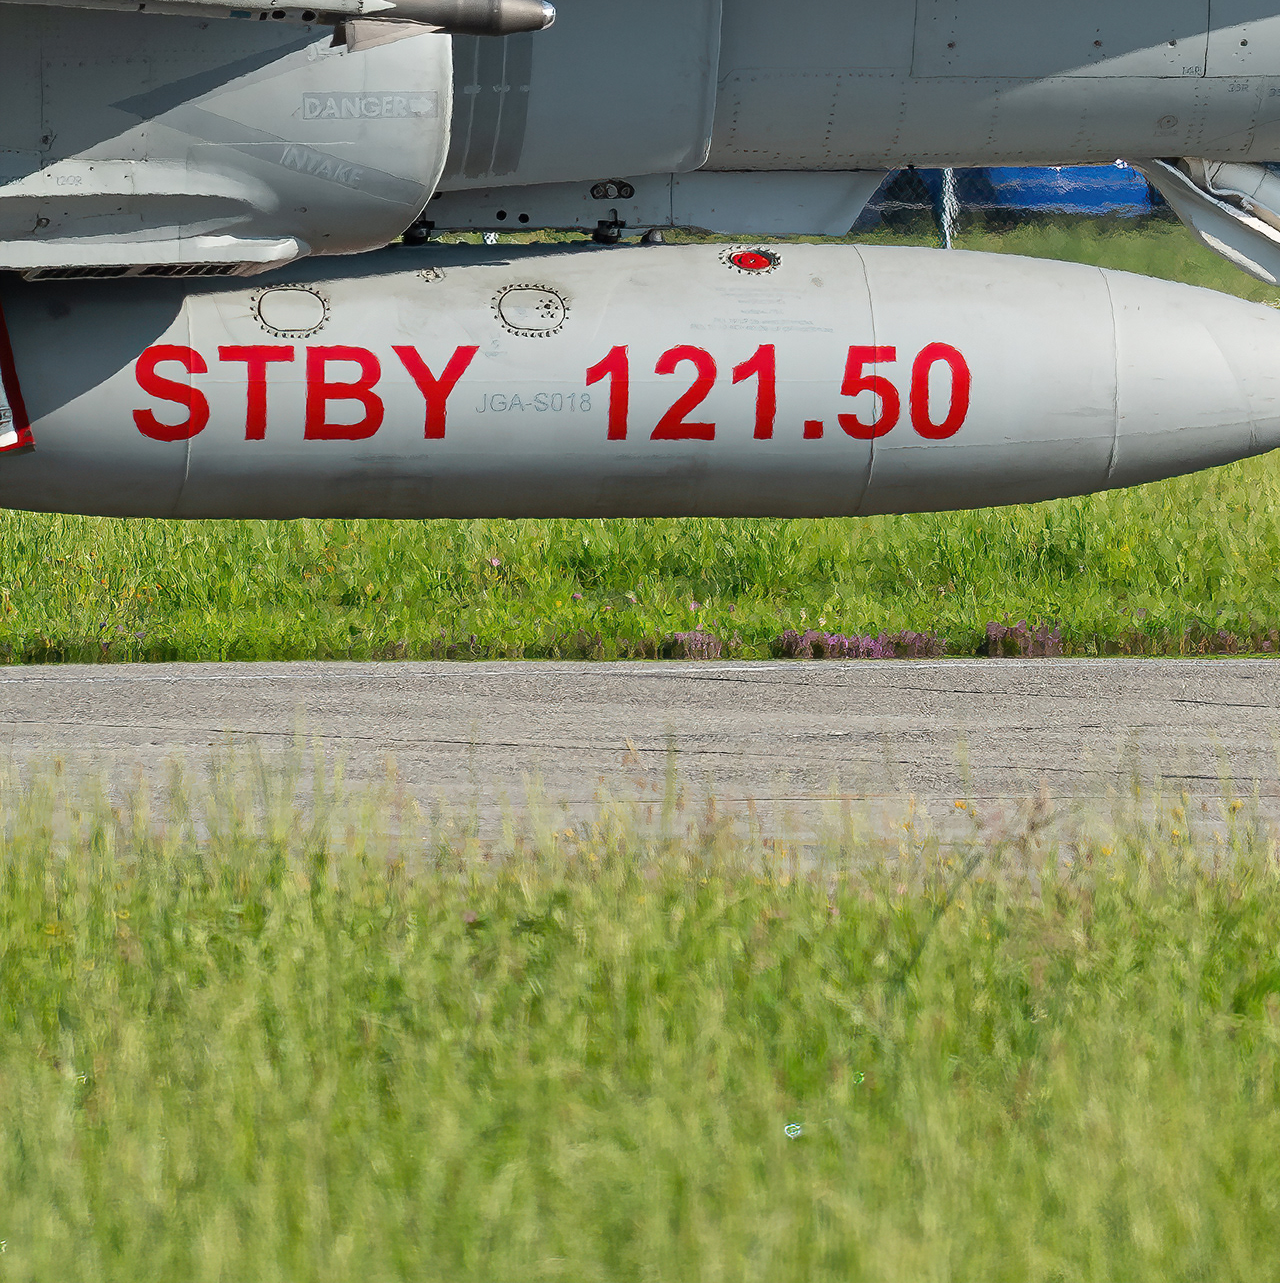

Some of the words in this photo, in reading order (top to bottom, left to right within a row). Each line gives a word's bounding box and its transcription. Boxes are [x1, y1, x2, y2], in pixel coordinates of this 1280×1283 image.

[304, 96, 408, 118] DANGER
[132, 344, 480, 441] STBY
[585, 342, 971, 441] 121.50
